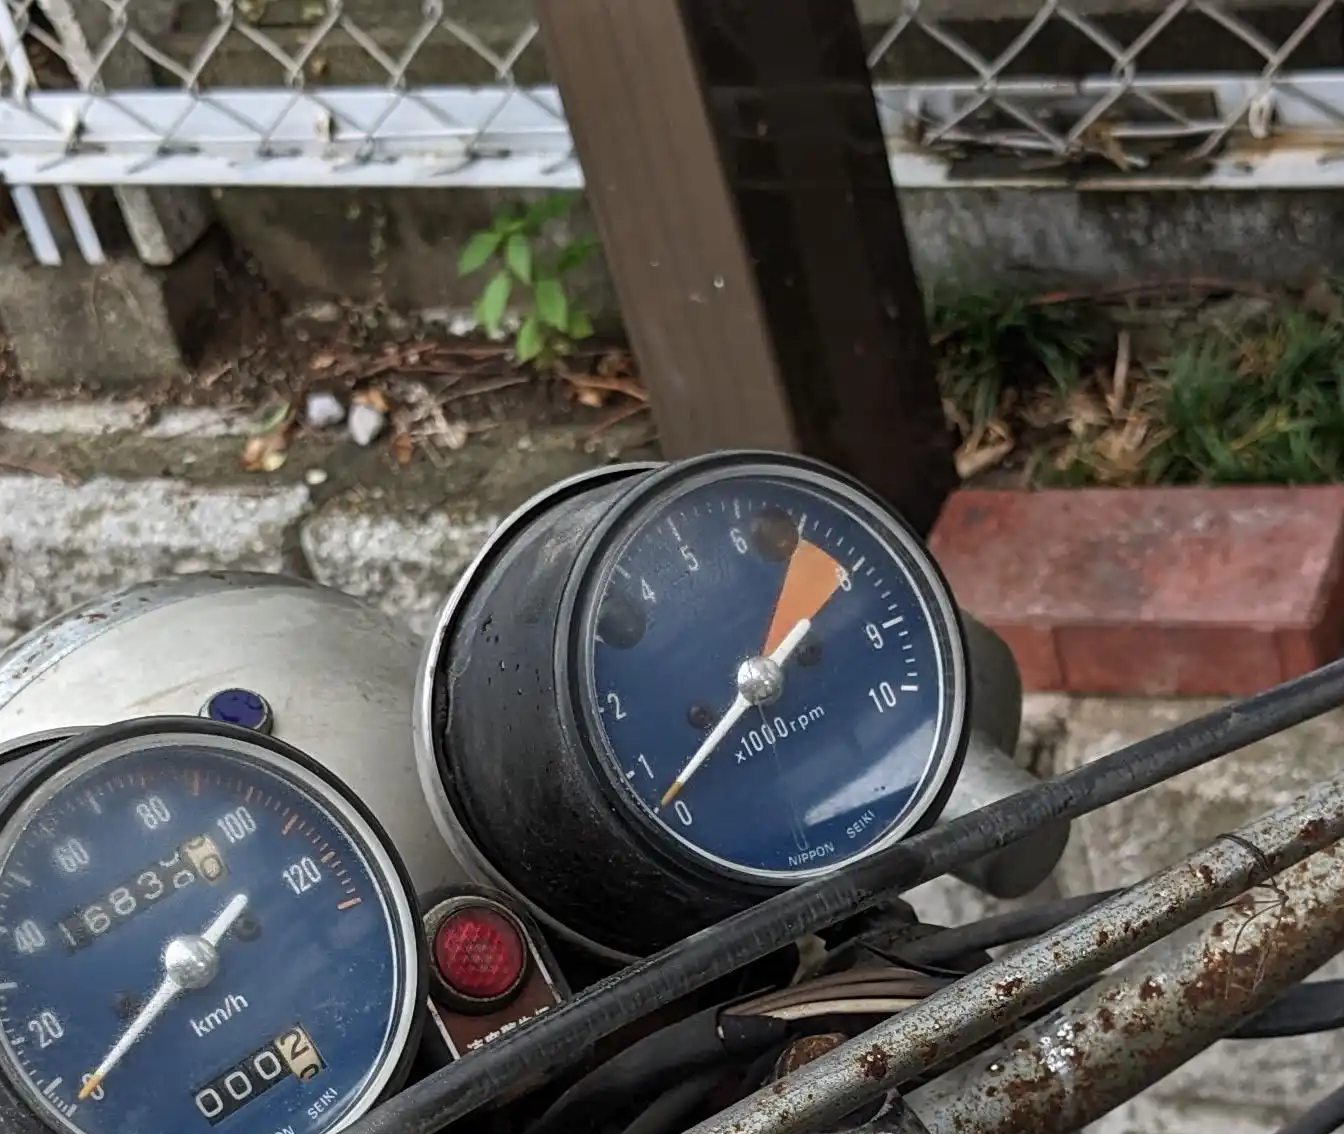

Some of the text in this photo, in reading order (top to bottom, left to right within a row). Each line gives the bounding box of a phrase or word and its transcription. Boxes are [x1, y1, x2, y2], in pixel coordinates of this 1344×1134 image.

[730, 527, 748, 555] 6
[680, 545, 700, 572] 5
[640, 578, 656, 603] 4
[835, 565, 853, 592] 8
[865, 623, 884, 649] 9
[607, 693, 627, 720] 2
[868, 680, 897, 713] 10
[637, 753, 654, 779] 1
[136, 796, 171, 830] 80
[217, 806, 256, 843] 100
[674, 800, 692, 826] 0
[787, 809, 876, 867] NIPPON SEIKI
[55, 838, 90, 873] 60
[281, 856, 322, 896] 120
[14, 919, 46, 953] 40
[28, 1012, 64, 1049] 20
[189, 994, 249, 1037] km/h
[307, 1087, 338, 1119] SEIKI
